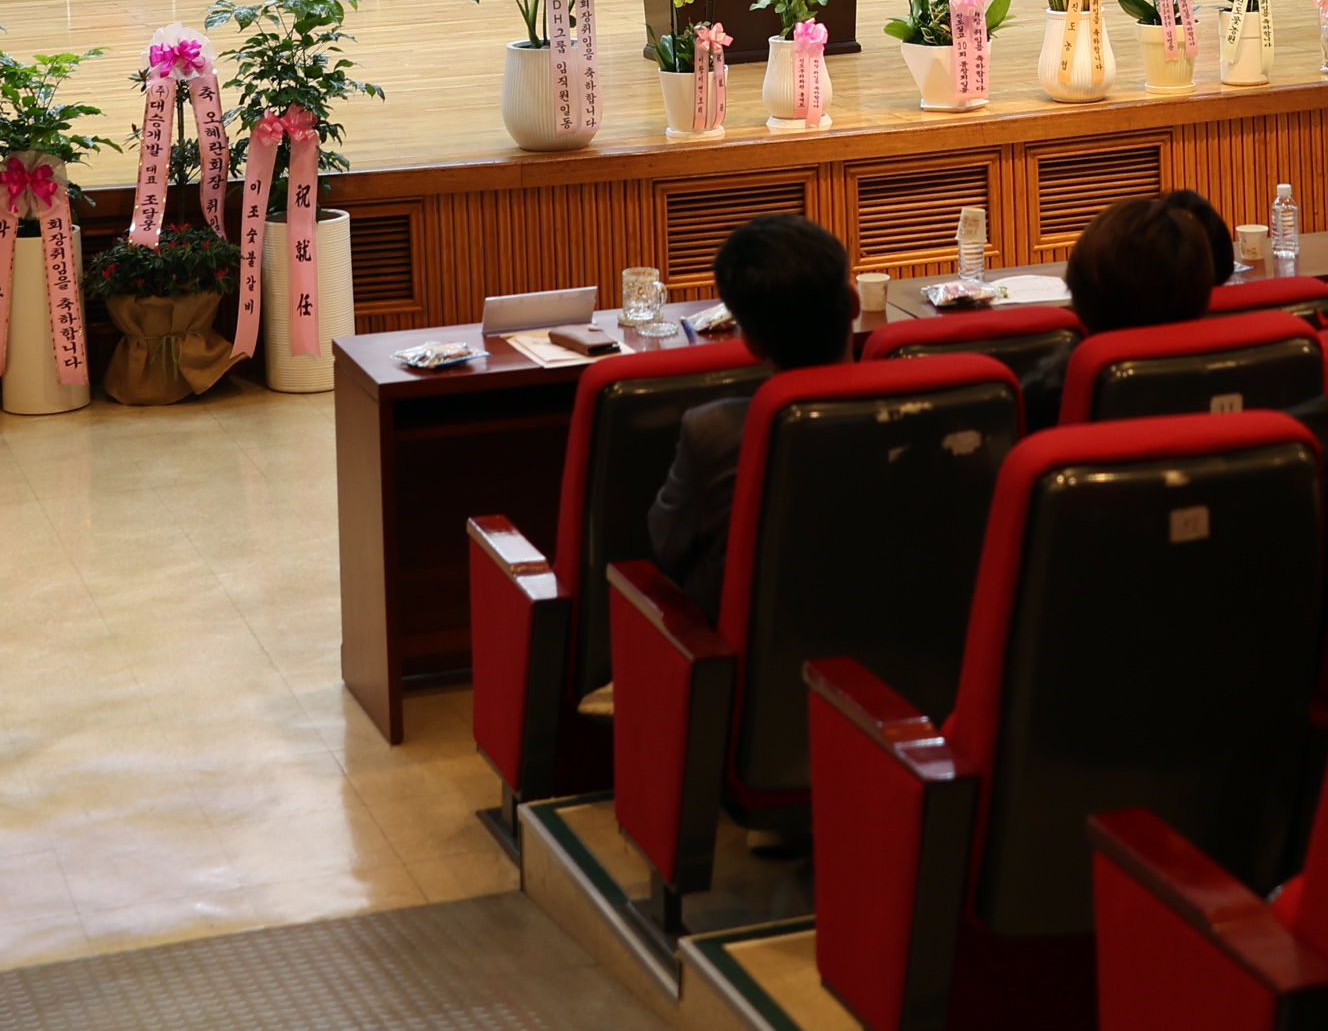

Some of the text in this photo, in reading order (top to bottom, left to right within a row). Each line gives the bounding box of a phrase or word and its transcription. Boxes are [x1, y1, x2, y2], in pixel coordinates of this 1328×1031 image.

[198, 86, 216, 100] 축
[552, 0, 573, 129] DH그룹 임직원일동
[583, 66, 597, 129] 축하합니다
[145, 85, 171, 158] (주)대승개발
[202, 111, 226, 190] 오혜란회장
[145, 165, 158, 185] 대표
[46, 218, 82, 370] 회장취임을 축하합니다
